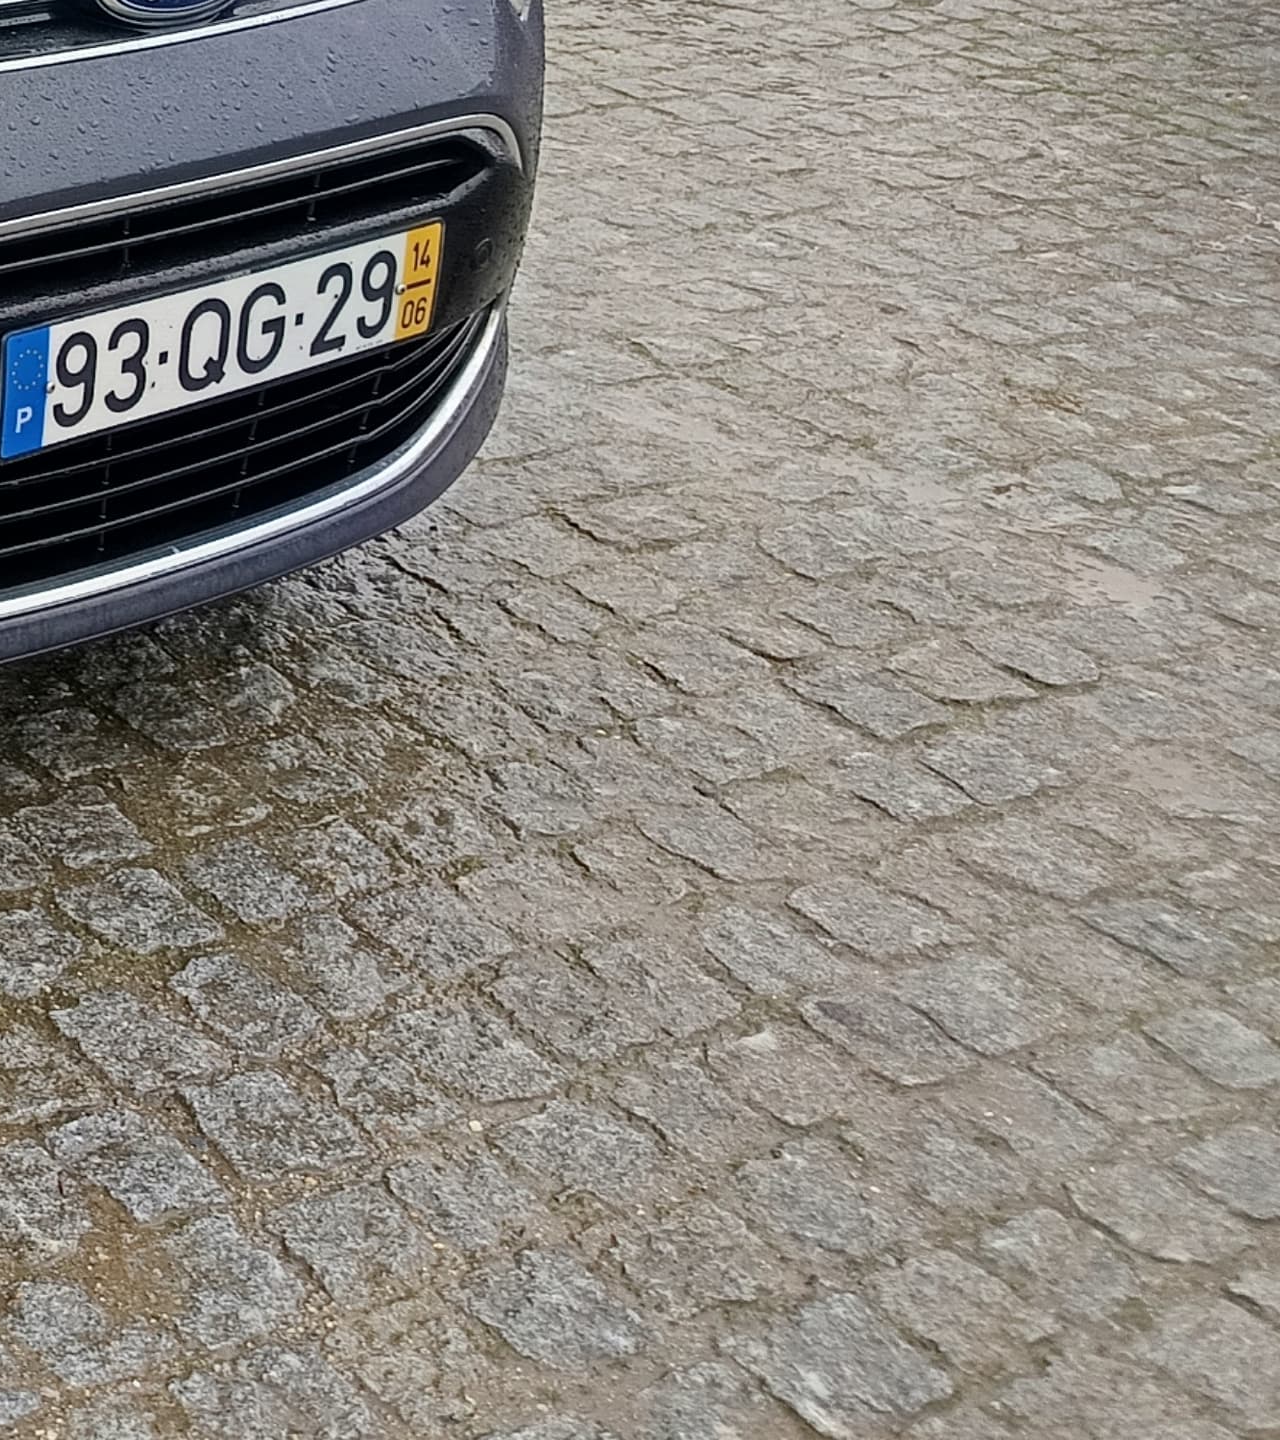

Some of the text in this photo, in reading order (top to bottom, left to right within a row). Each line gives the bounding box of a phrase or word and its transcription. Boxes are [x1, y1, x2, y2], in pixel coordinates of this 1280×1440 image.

[412, 239, 431, 272] 14
[401, 296, 428, 329] 06
[15, 406, 32, 433] P
